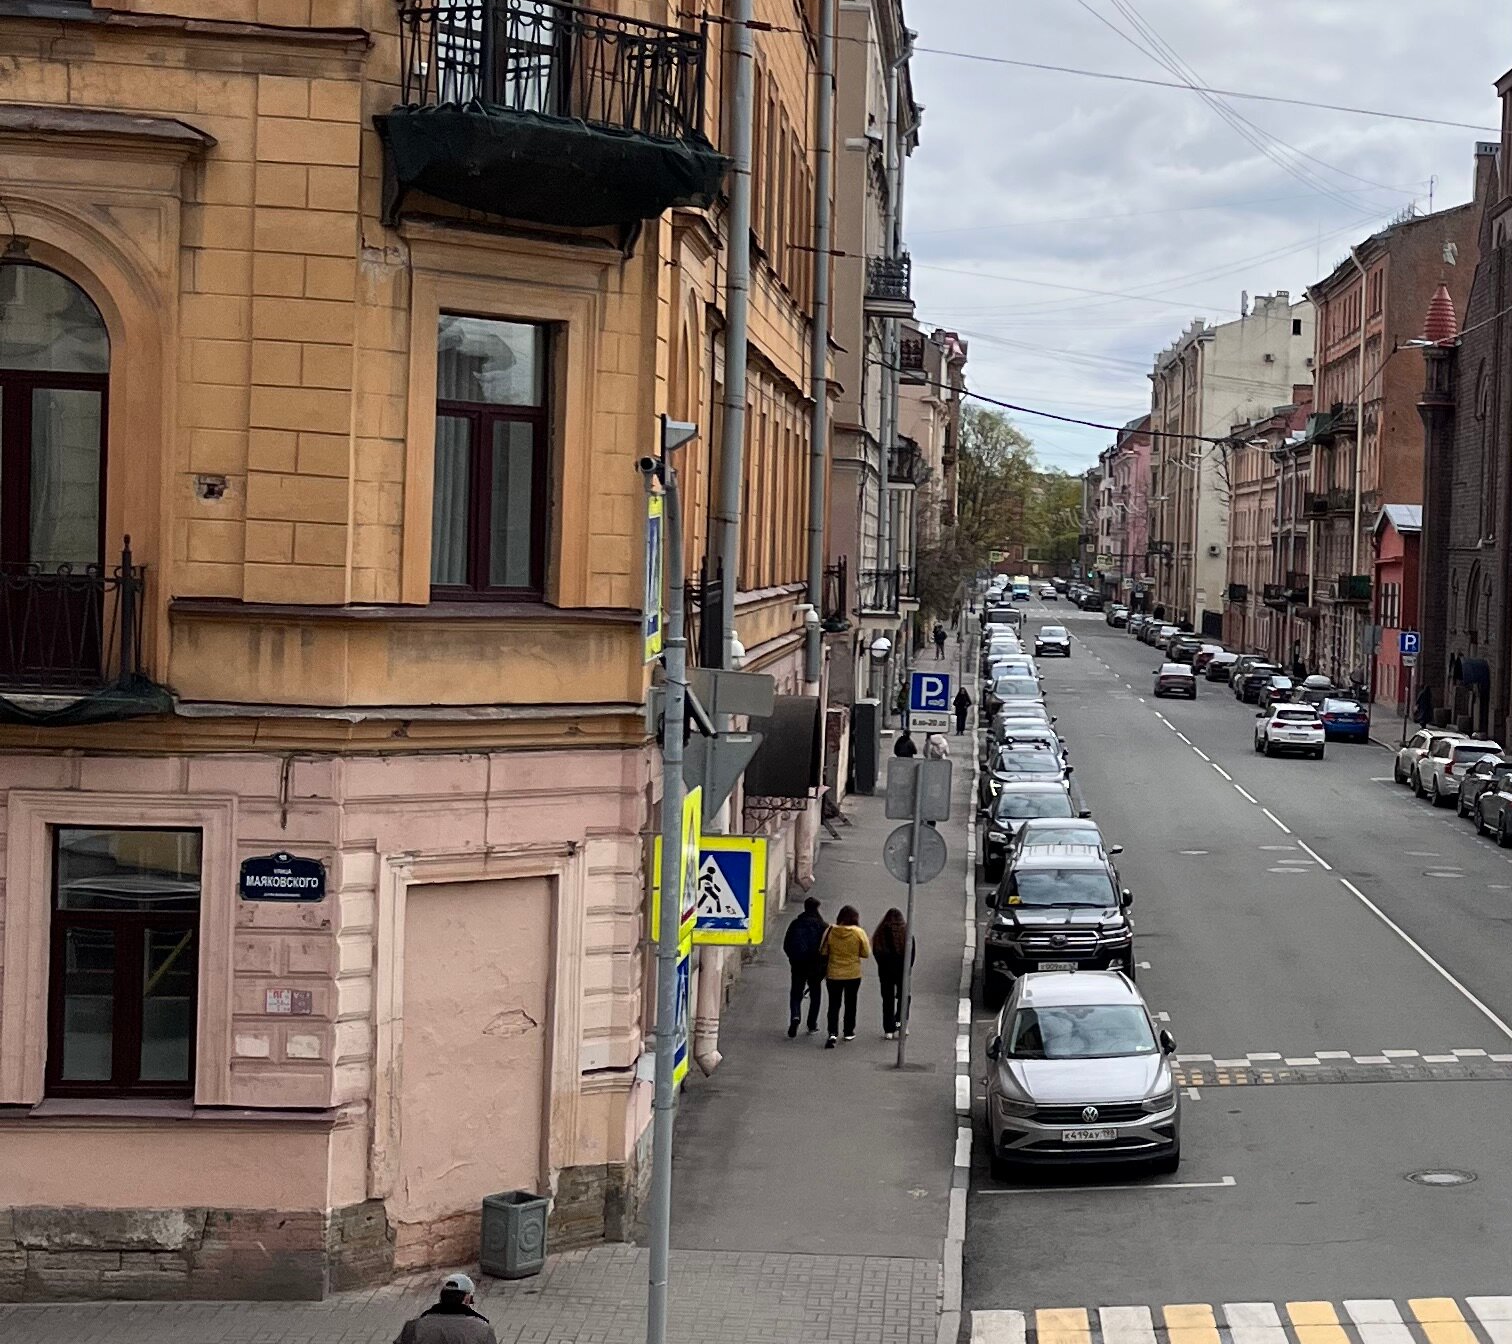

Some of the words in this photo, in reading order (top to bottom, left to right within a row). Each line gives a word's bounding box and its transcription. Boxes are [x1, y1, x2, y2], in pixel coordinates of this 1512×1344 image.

[1405, 635, 1417, 651] P
[921, 676, 944, 707] P
[246, 875, 319, 888] МАЯКОВСКОГО
